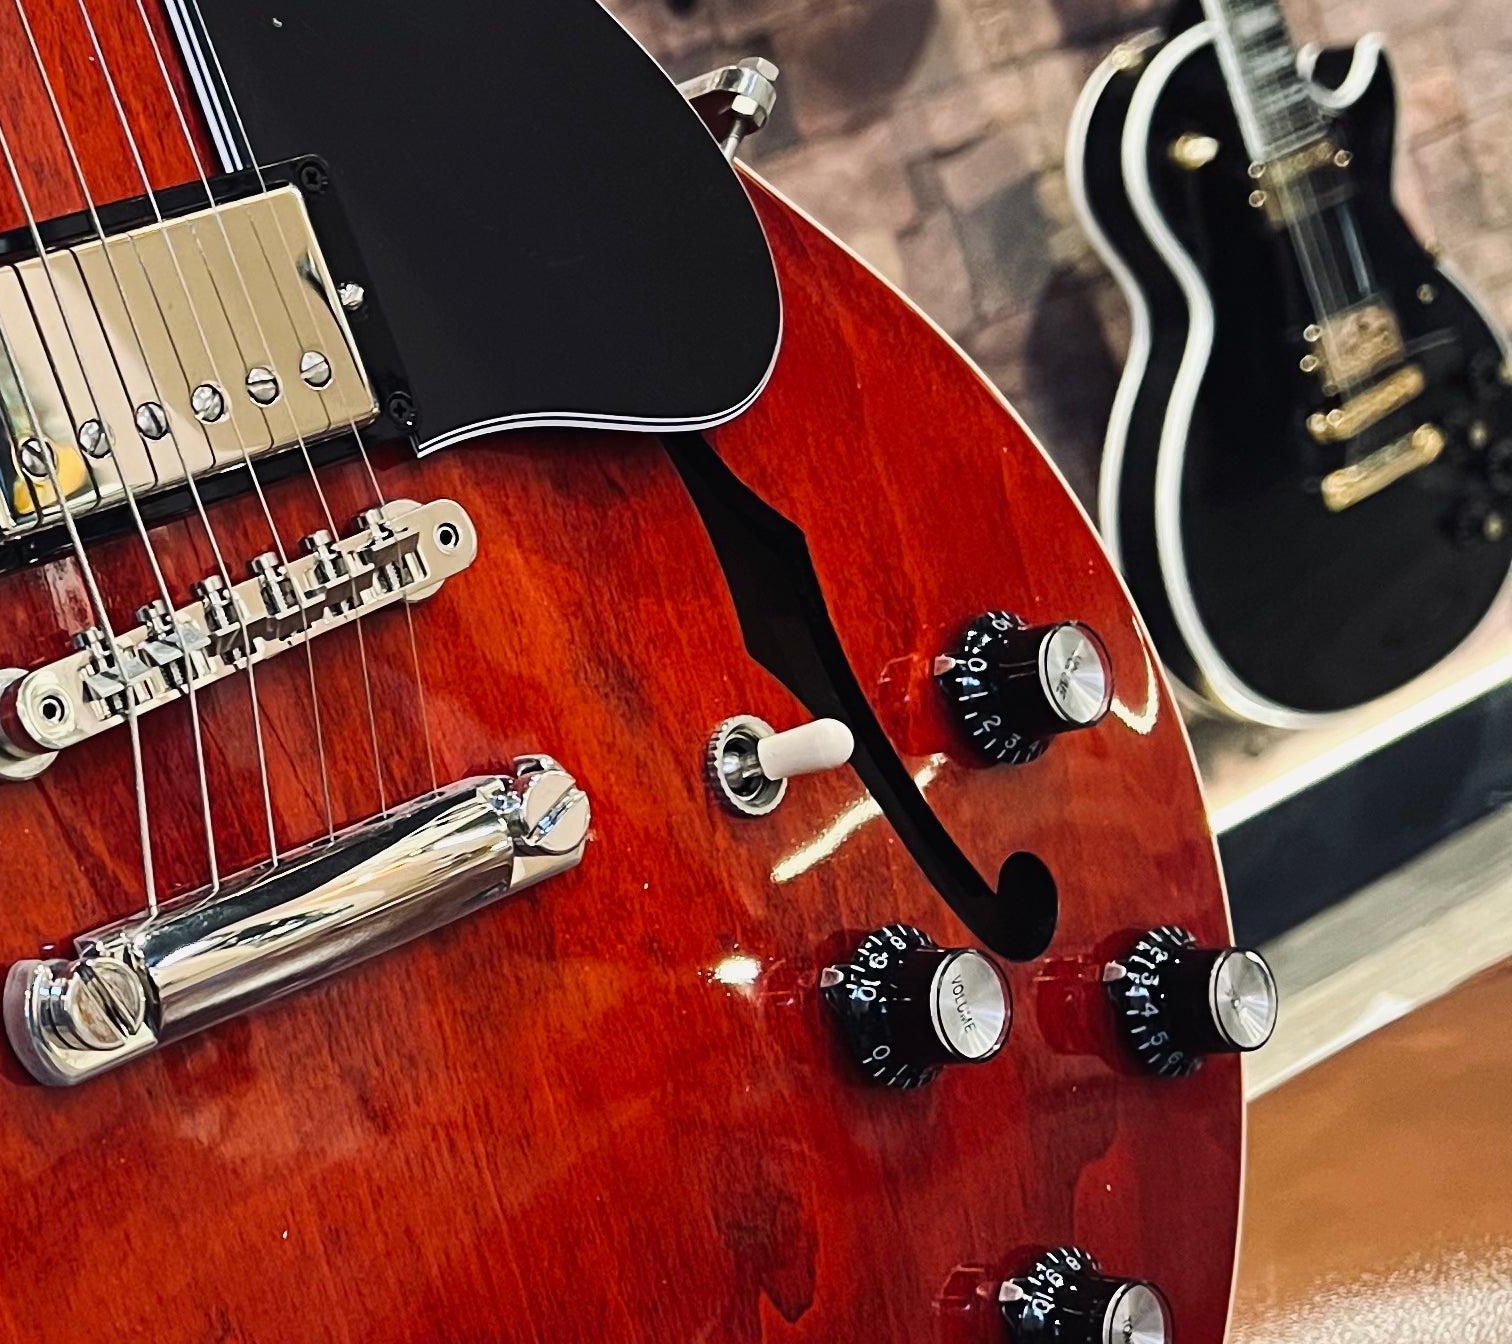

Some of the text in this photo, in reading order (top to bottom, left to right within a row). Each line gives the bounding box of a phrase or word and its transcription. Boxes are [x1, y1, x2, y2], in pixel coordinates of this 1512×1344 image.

[967, 657, 988, 673] 0
[982, 715, 1002, 732] 2
[1004, 733, 1021, 749] 3
[890, 935, 907, 950] 8
[951, 974, 977, 1033] VOLUME
[1141, 1002, 1159, 1017] 4
[1151, 1031, 1168, 1046] 5
[1168, 1051, 1183, 1064] 6
[872, 1045, 891, 1060] 0
[1066, 1256, 1081, 1271] 8
